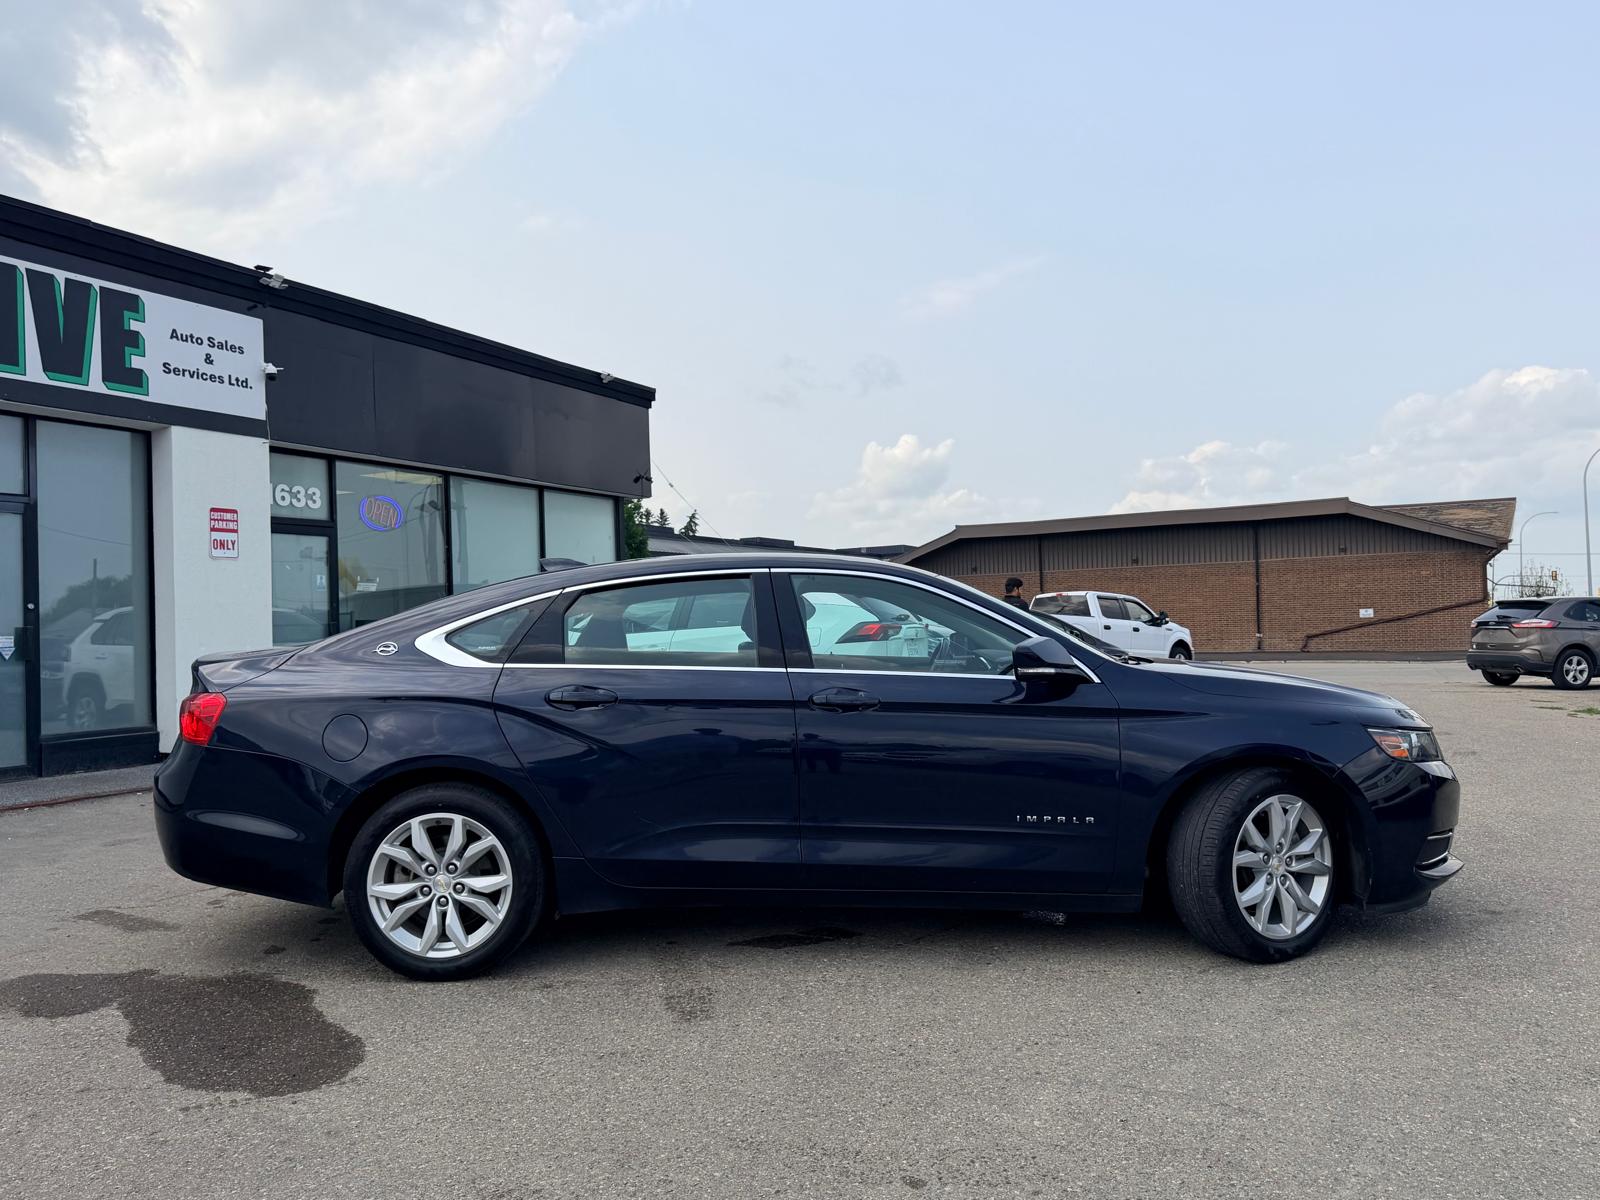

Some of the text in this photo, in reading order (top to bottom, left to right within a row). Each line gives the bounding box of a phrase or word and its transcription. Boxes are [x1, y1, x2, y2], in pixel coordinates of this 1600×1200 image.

[169, 328, 245, 355] Auto Sales
[203, 353, 214, 366] &
[162, 362, 253, 390] Services Ltd.
[210, 511, 238, 521] CUSTOMER
[366, 498, 398, 528] OPEN
[210, 520, 238, 530] PARKING
[212, 538, 236, 550] ONLY
[1016, 815, 1095, 824] IMPALA
